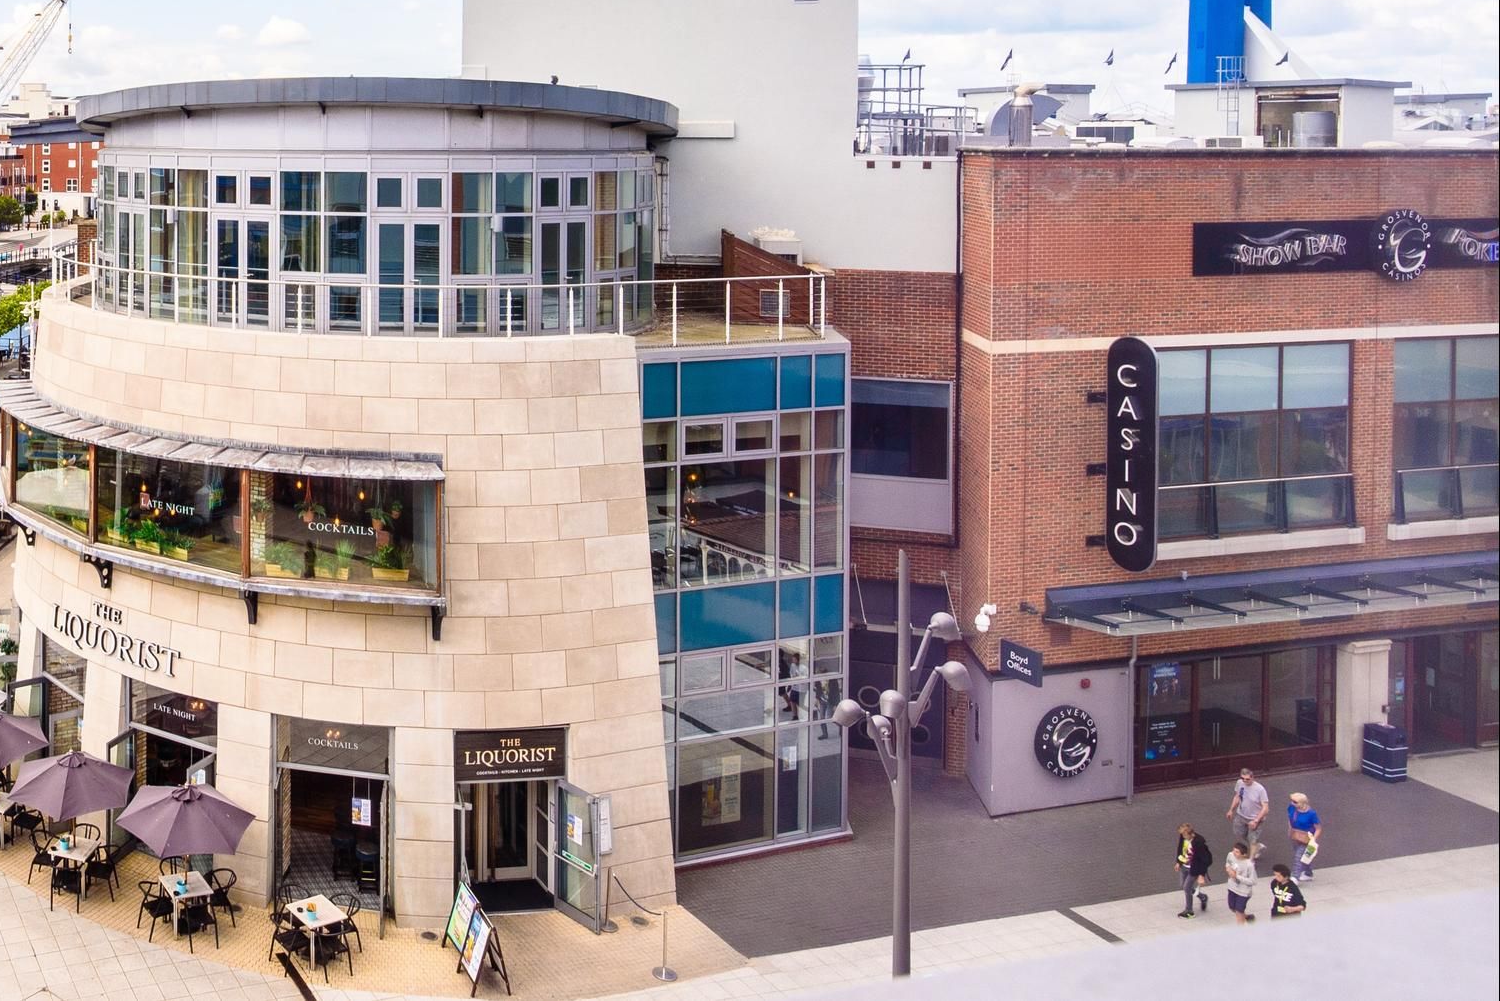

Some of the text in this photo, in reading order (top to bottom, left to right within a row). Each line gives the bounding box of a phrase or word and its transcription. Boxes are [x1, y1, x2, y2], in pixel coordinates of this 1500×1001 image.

[1378, 209, 1431, 241] GROSVENOR
[1238, 233, 1347, 266] SHOW BAR
[1382, 262, 1426, 281] CASINOS
[1113, 364, 1138, 546] CASINO
[141, 497, 195, 516] LATE NIGHT
[308, 521, 374, 536] COCKTAILS
[93, 601, 122, 624] THE
[52, 603, 181, 678] LIQUORIST
[1006, 659, 1032, 676] Offices
[1010, 650, 1028, 665] Boyd
[153, 702, 196, 722] LATE NIGHT
[1042, 708, 1096, 741] GROSVENOR
[307, 737, 359, 751] COCKTAILS
[499, 738, 521, 748] THE
[464, 747, 556, 768] LIQUORIST
